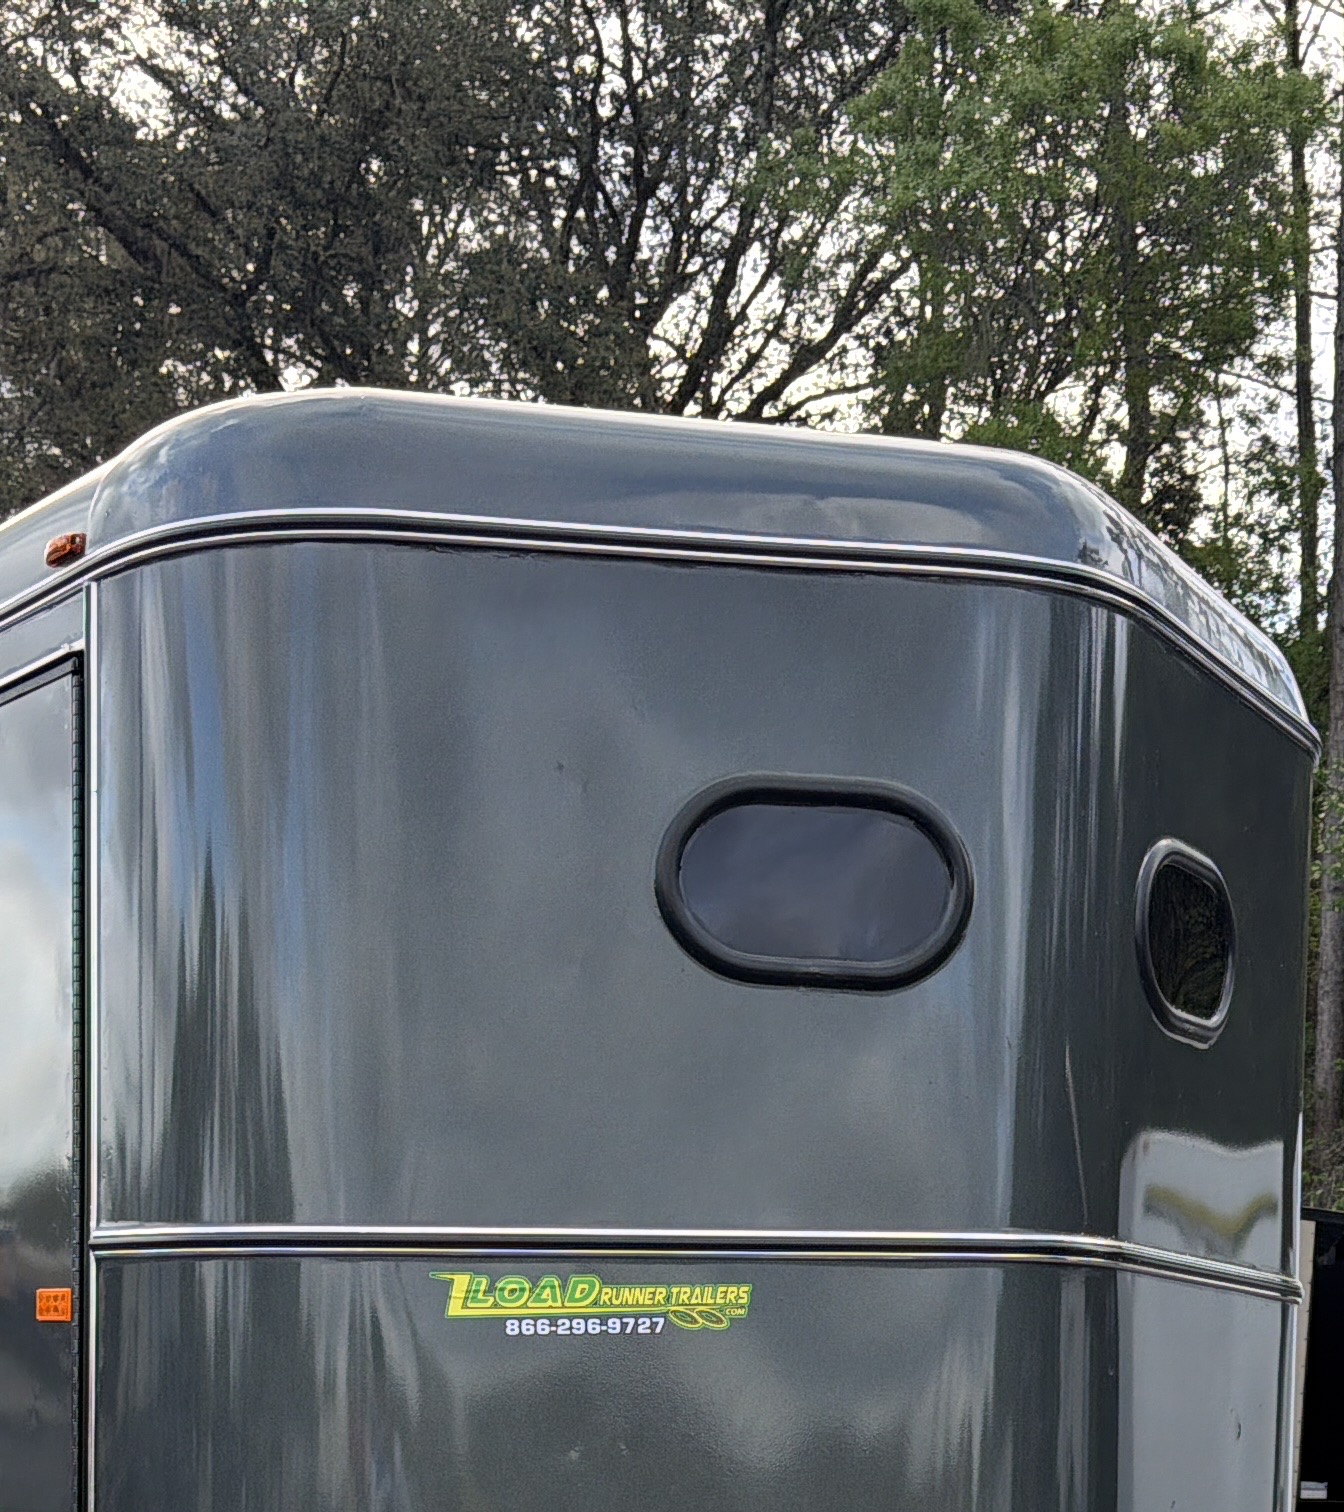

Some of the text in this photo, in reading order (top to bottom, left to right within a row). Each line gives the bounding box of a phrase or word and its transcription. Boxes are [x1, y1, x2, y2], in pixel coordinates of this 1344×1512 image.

[466, 1274, 750, 1309] LOAD RUNNER TRAILERS
[505, 1317, 665, 1336] 866-296-9727
